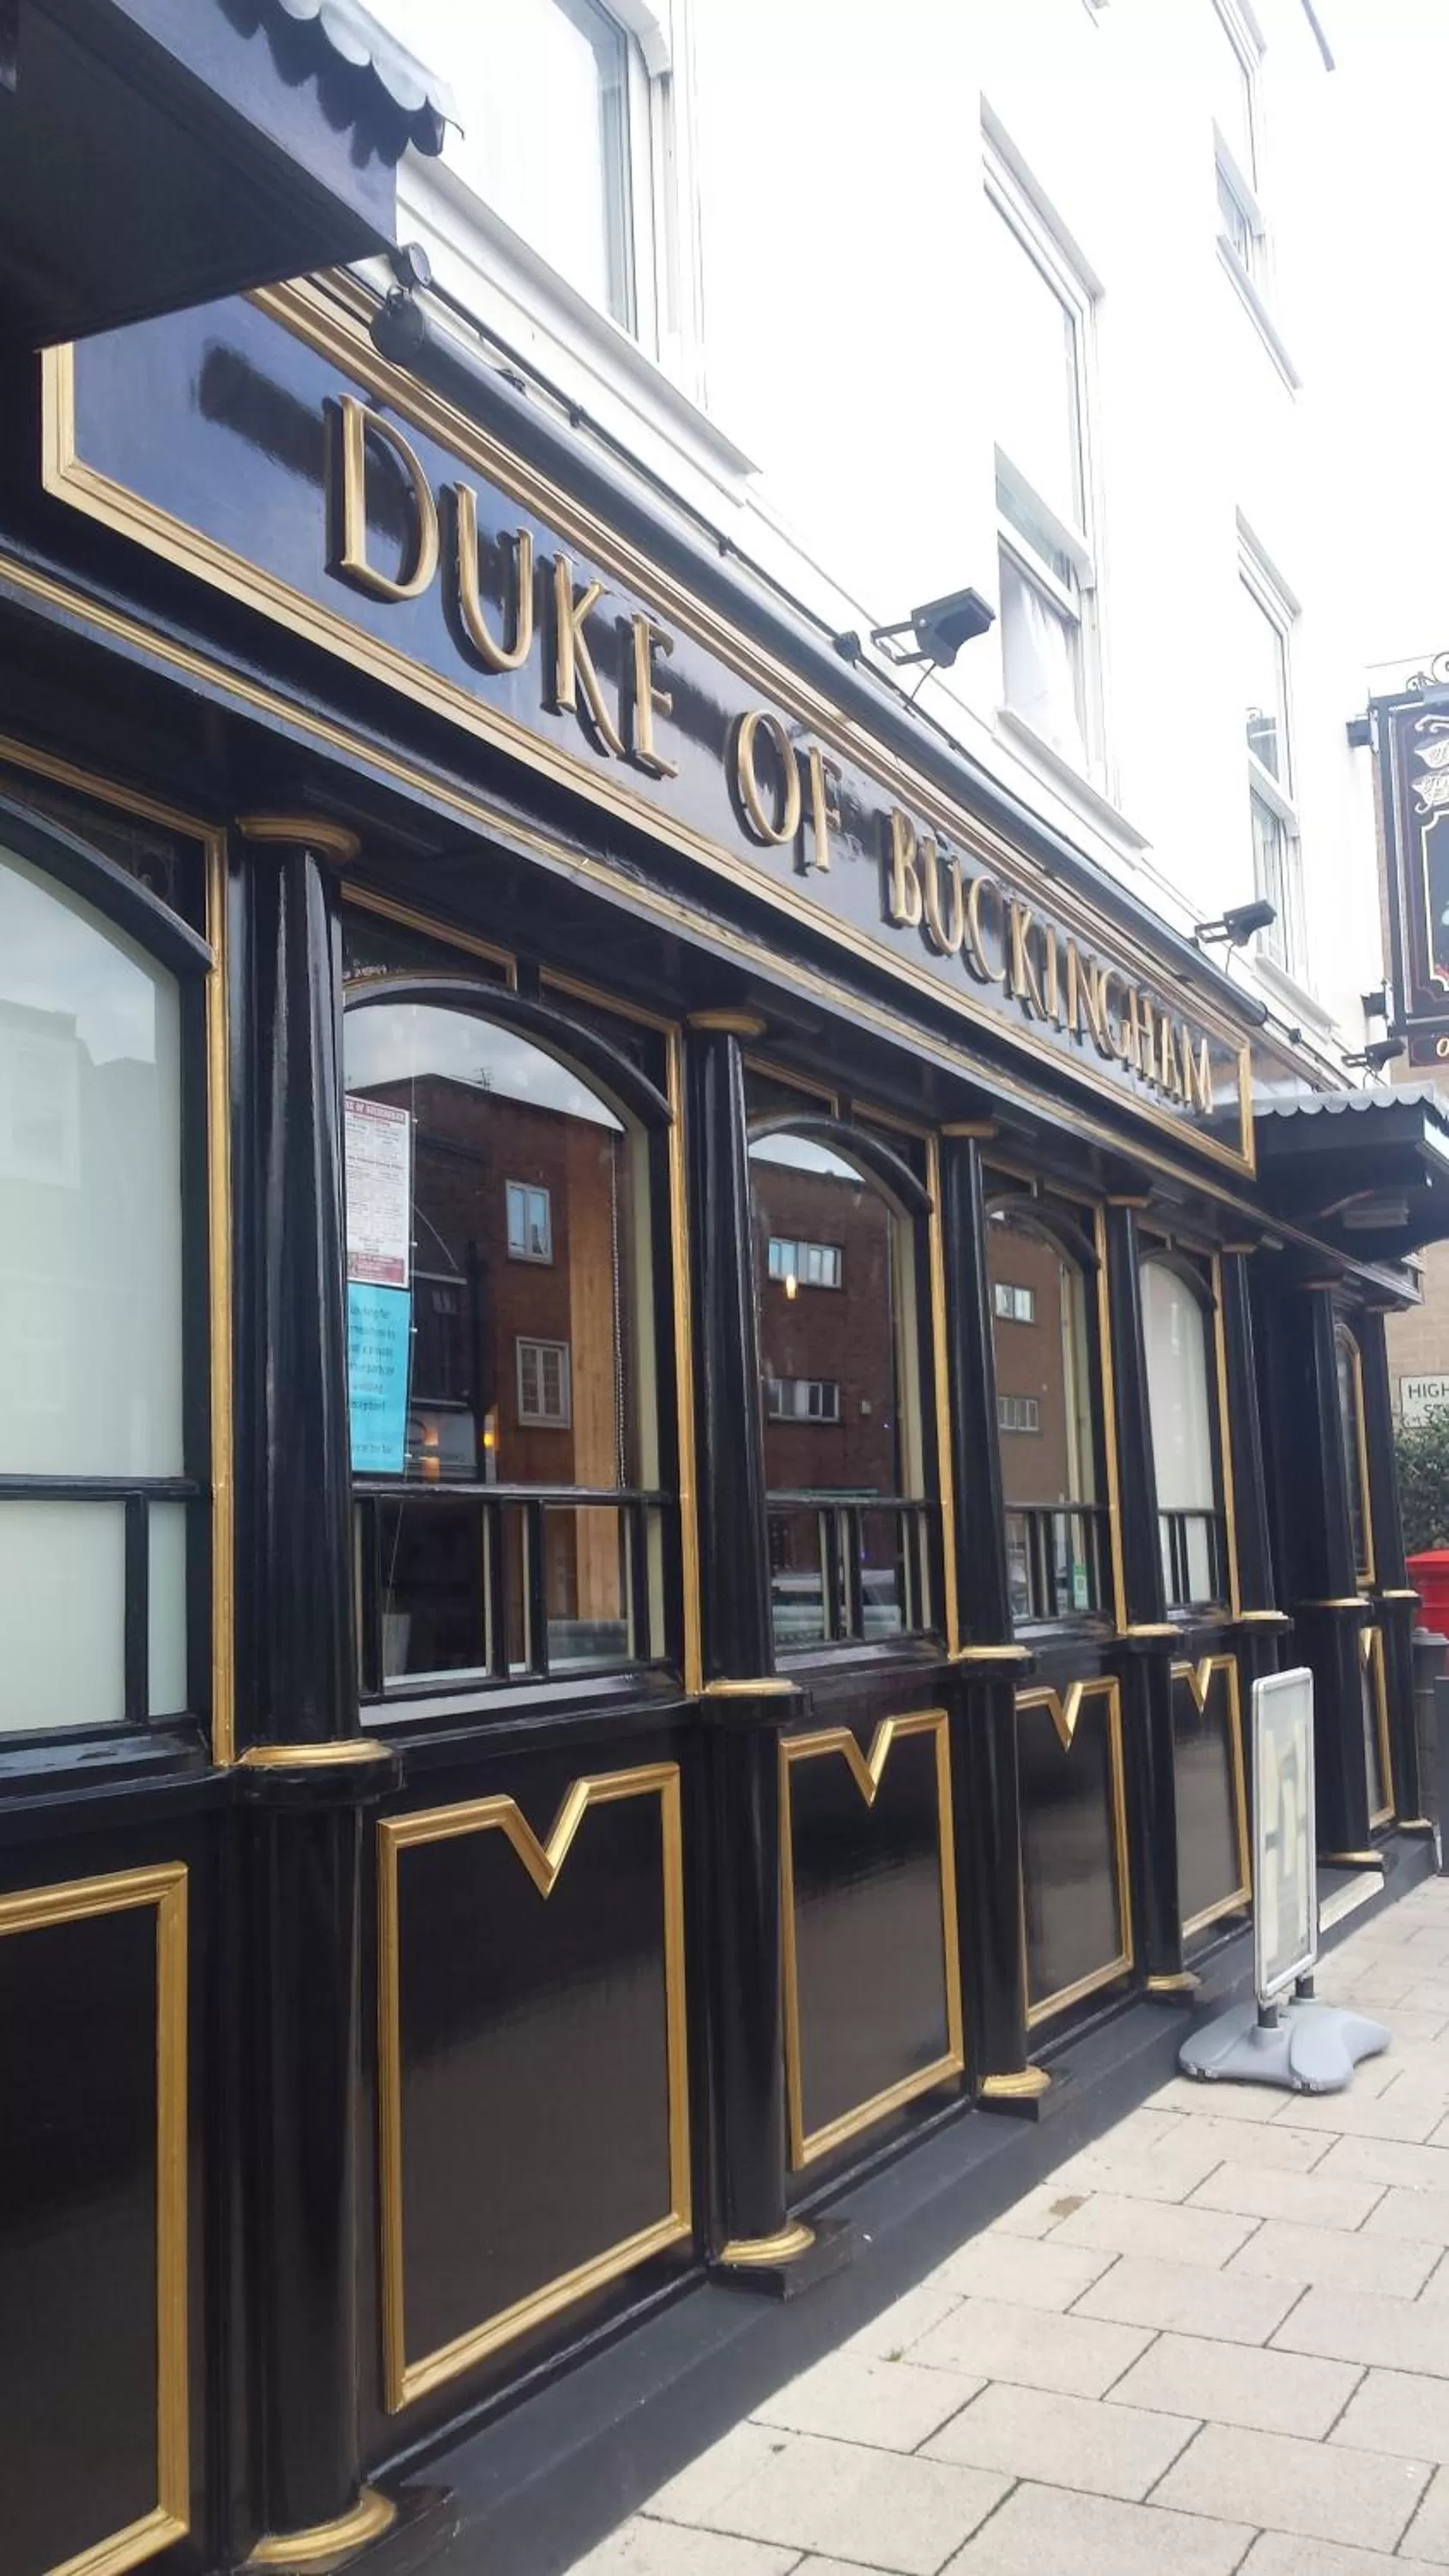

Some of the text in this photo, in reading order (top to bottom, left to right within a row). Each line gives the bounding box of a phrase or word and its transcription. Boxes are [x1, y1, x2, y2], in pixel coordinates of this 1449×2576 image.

[339, 392, 1214, 1115] DUKE OF BUCKINGHAM
